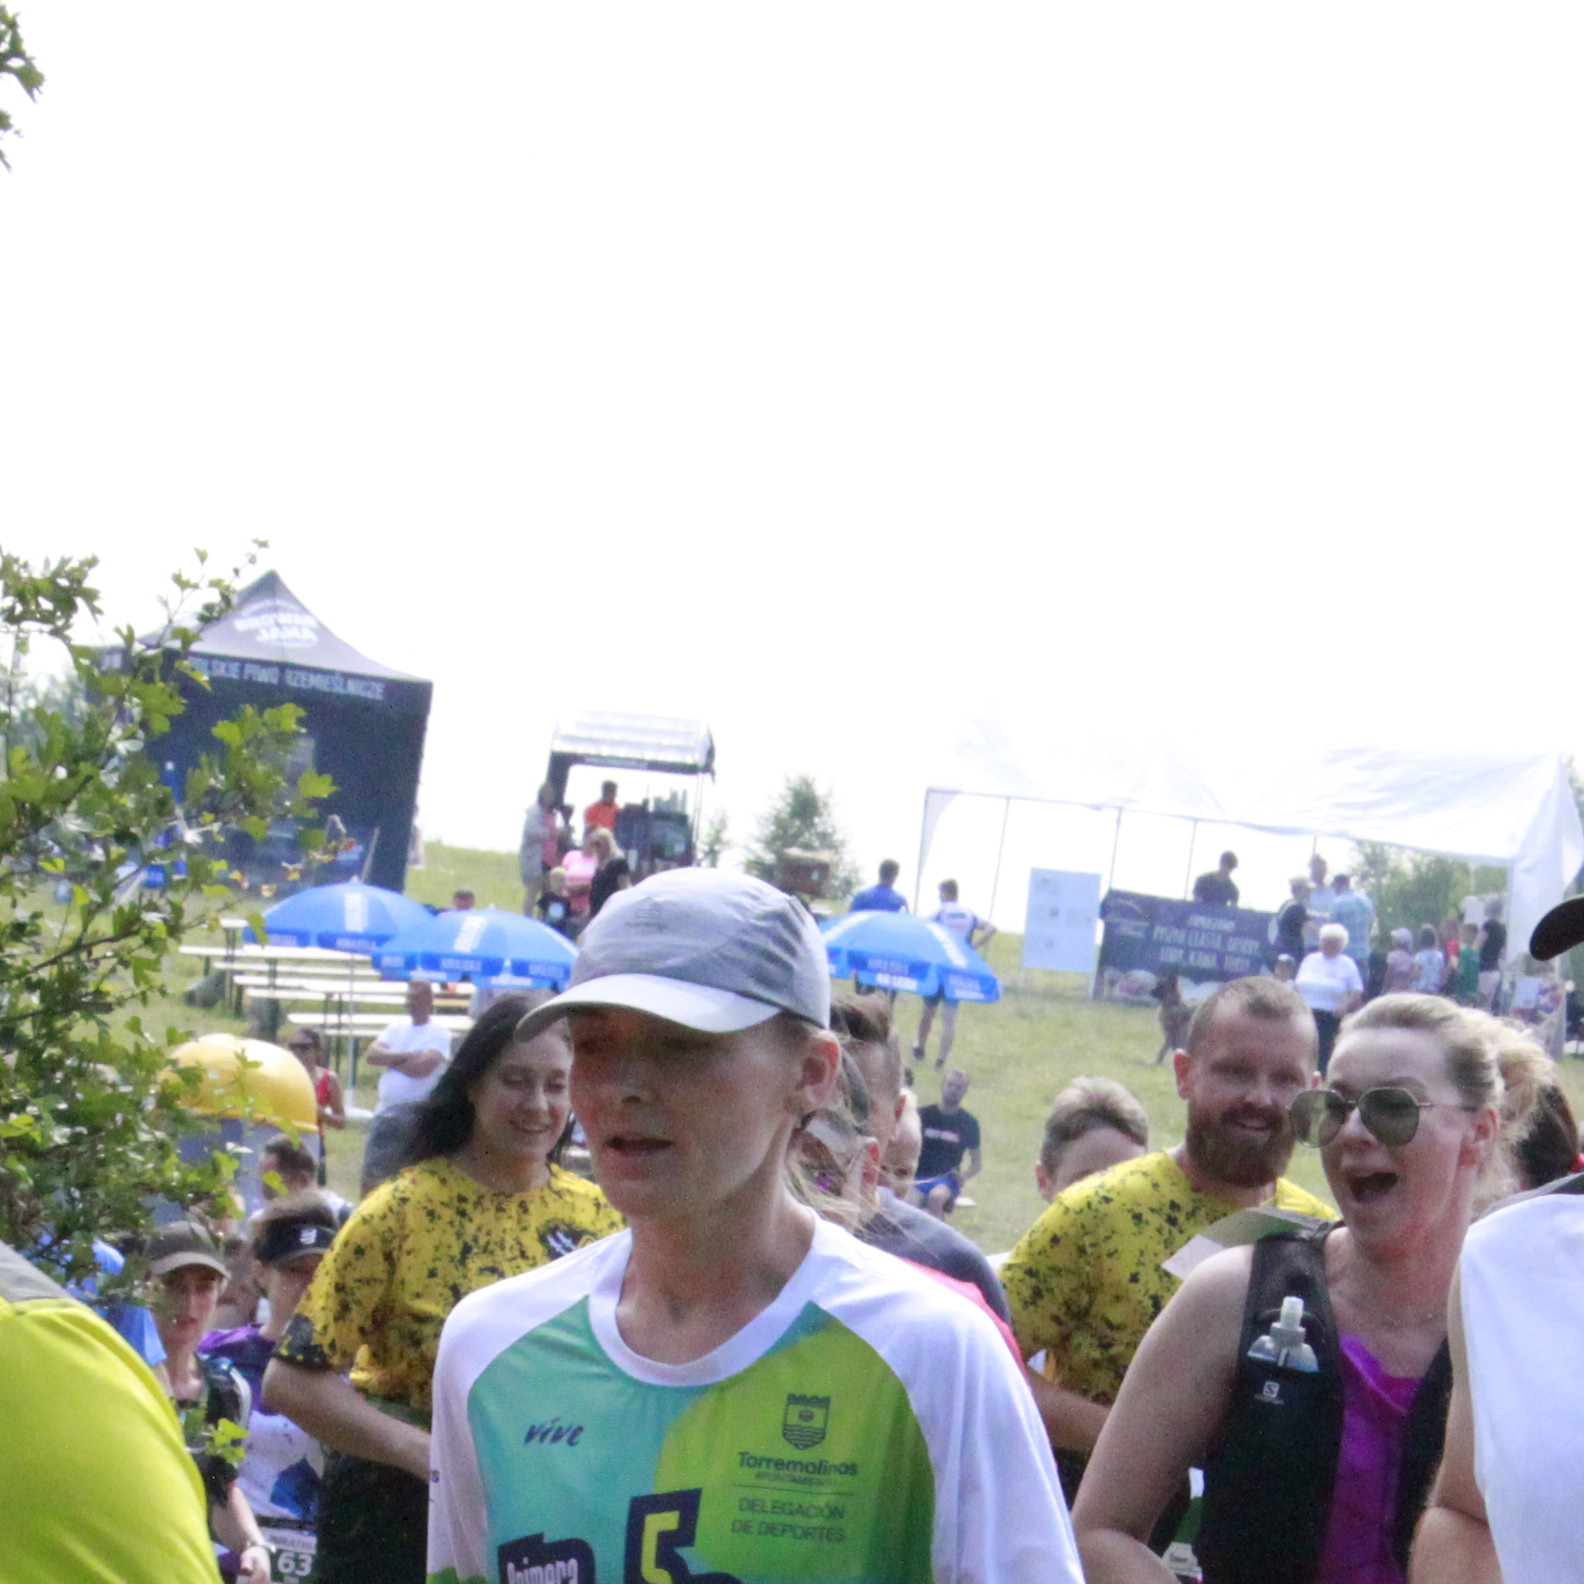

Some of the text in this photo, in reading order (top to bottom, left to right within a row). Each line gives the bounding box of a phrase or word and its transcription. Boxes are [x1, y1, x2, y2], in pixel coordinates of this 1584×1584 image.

[739, 1451, 858, 1476] Torremolinos
[731, 1519, 847, 1543] DE DEPORTES
[277, 1552, 313, 1577] 63
